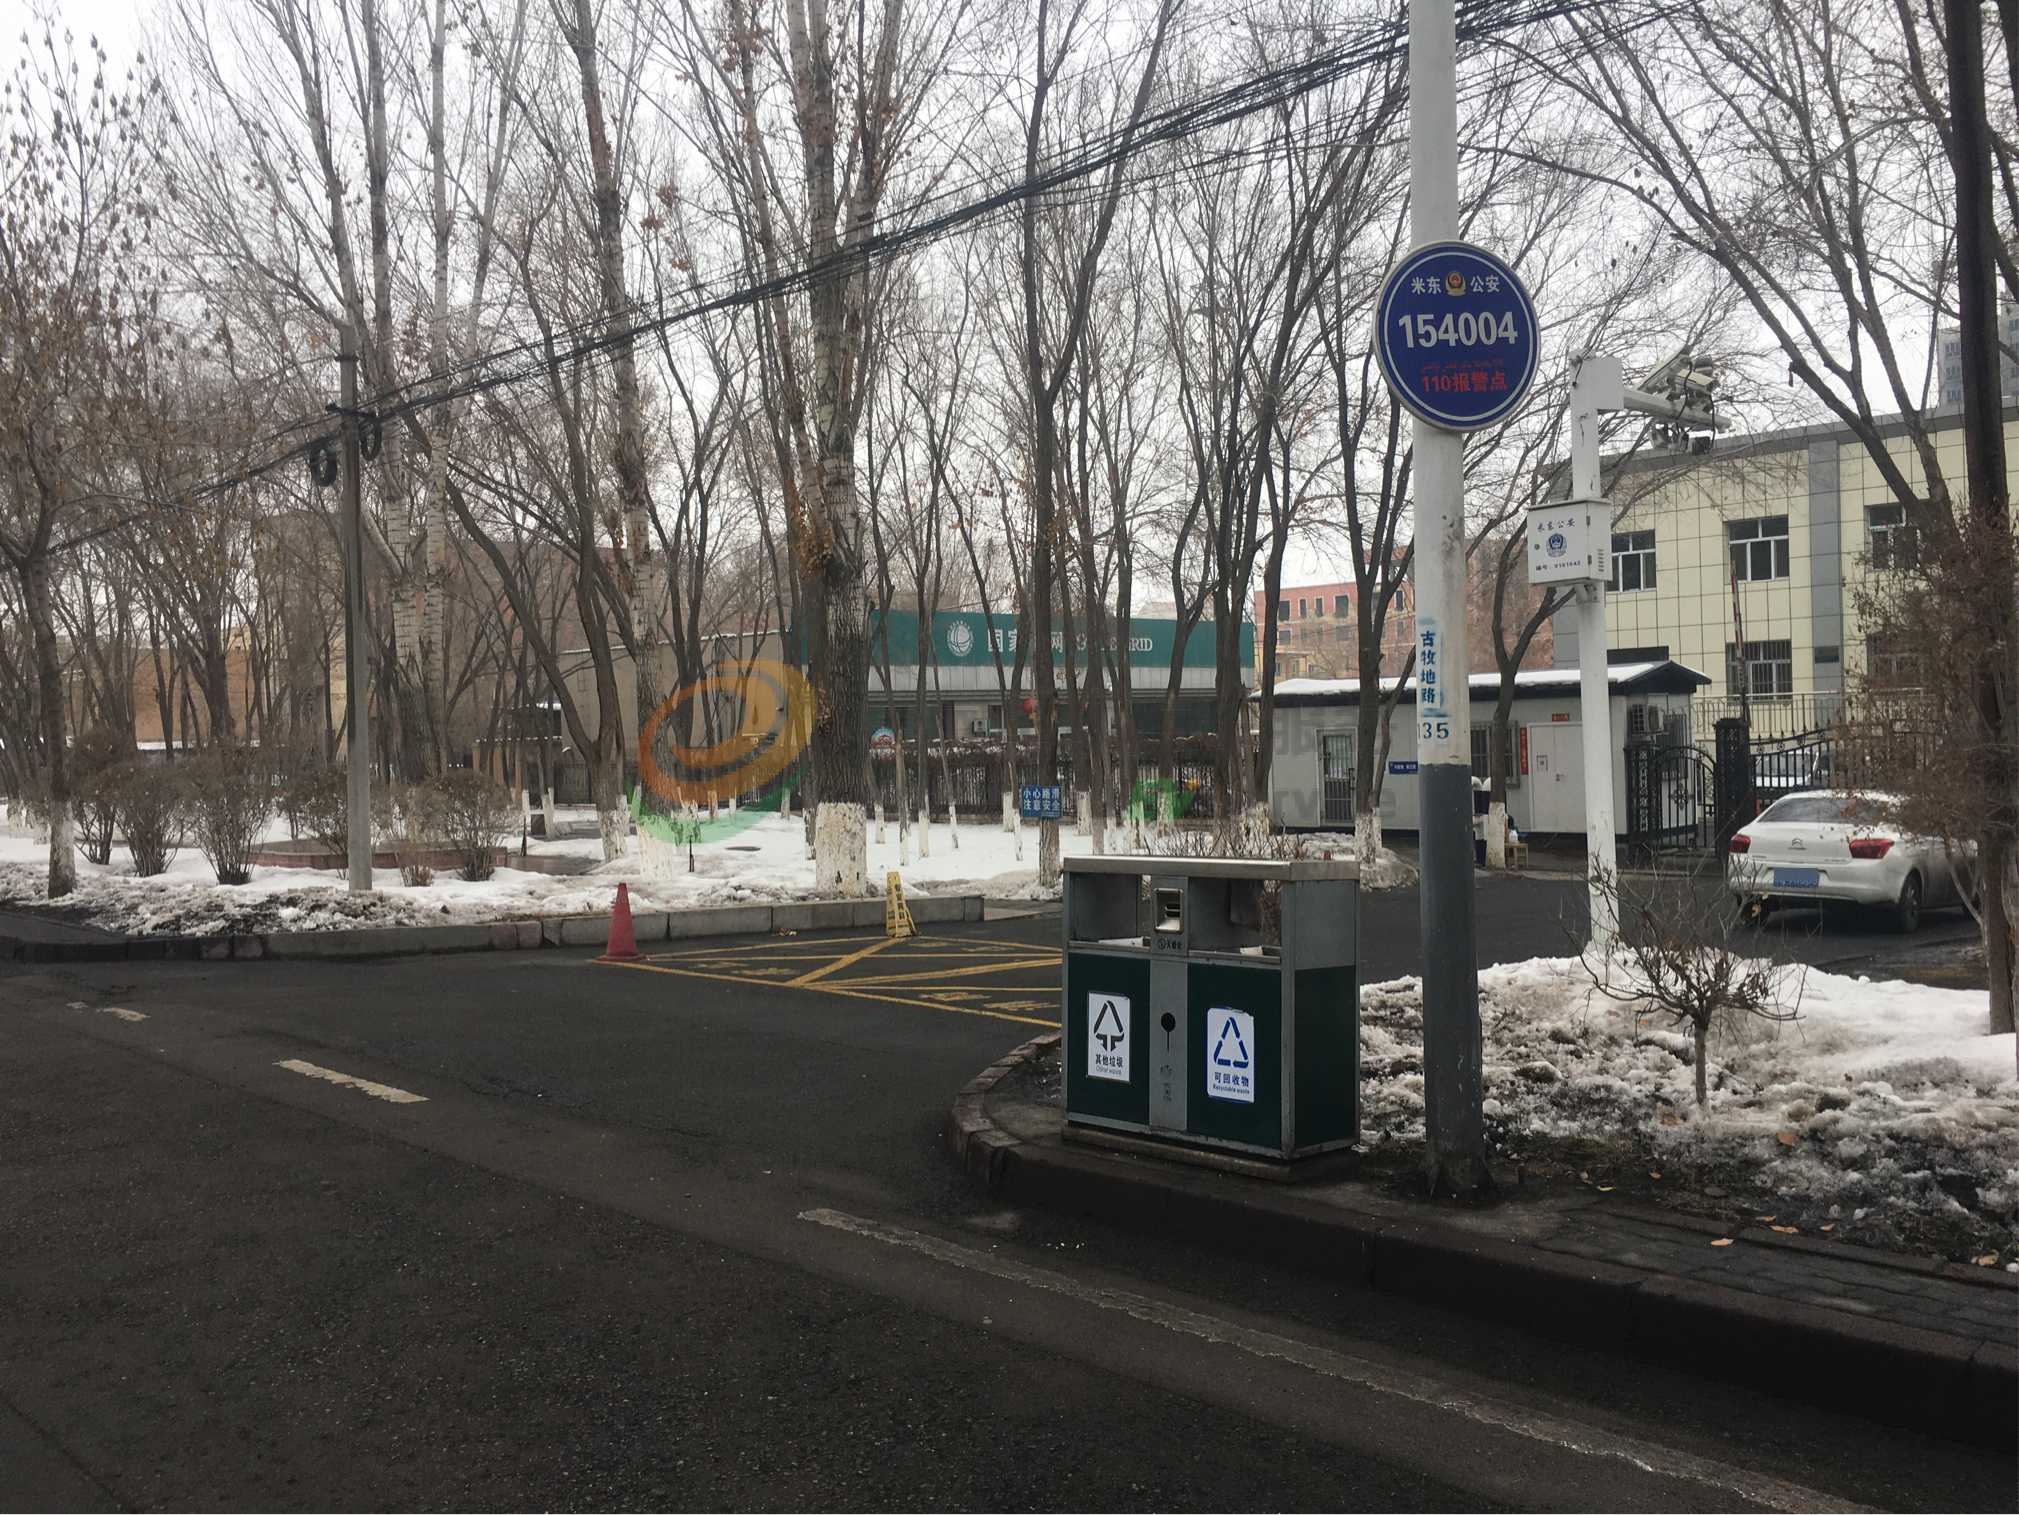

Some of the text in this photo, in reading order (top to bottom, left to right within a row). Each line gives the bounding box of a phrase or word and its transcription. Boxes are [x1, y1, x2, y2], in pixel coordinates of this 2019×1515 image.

[1411, 275, 1500, 295] 米东 公安
[1398, 311, 1518, 349] 154004
[1421, 370, 1508, 393] 110报警点
[1537, 518, 1576, 533] 米东公安
[987, 628, 1063, 654] 国家网
[1420, 630, 1437, 704] 古牧地路
[1023, 787, 1061, 800] 小心路滑
[1023, 799, 1061, 811] 注意安全
[1095, 1053, 1124, 1068] 其他垃圾
[1096, 1065, 1108, 1073] Other
[1214, 1072, 1249, 1087] 可回收物
[1213, 1083, 1236, 1093] Recyclable
